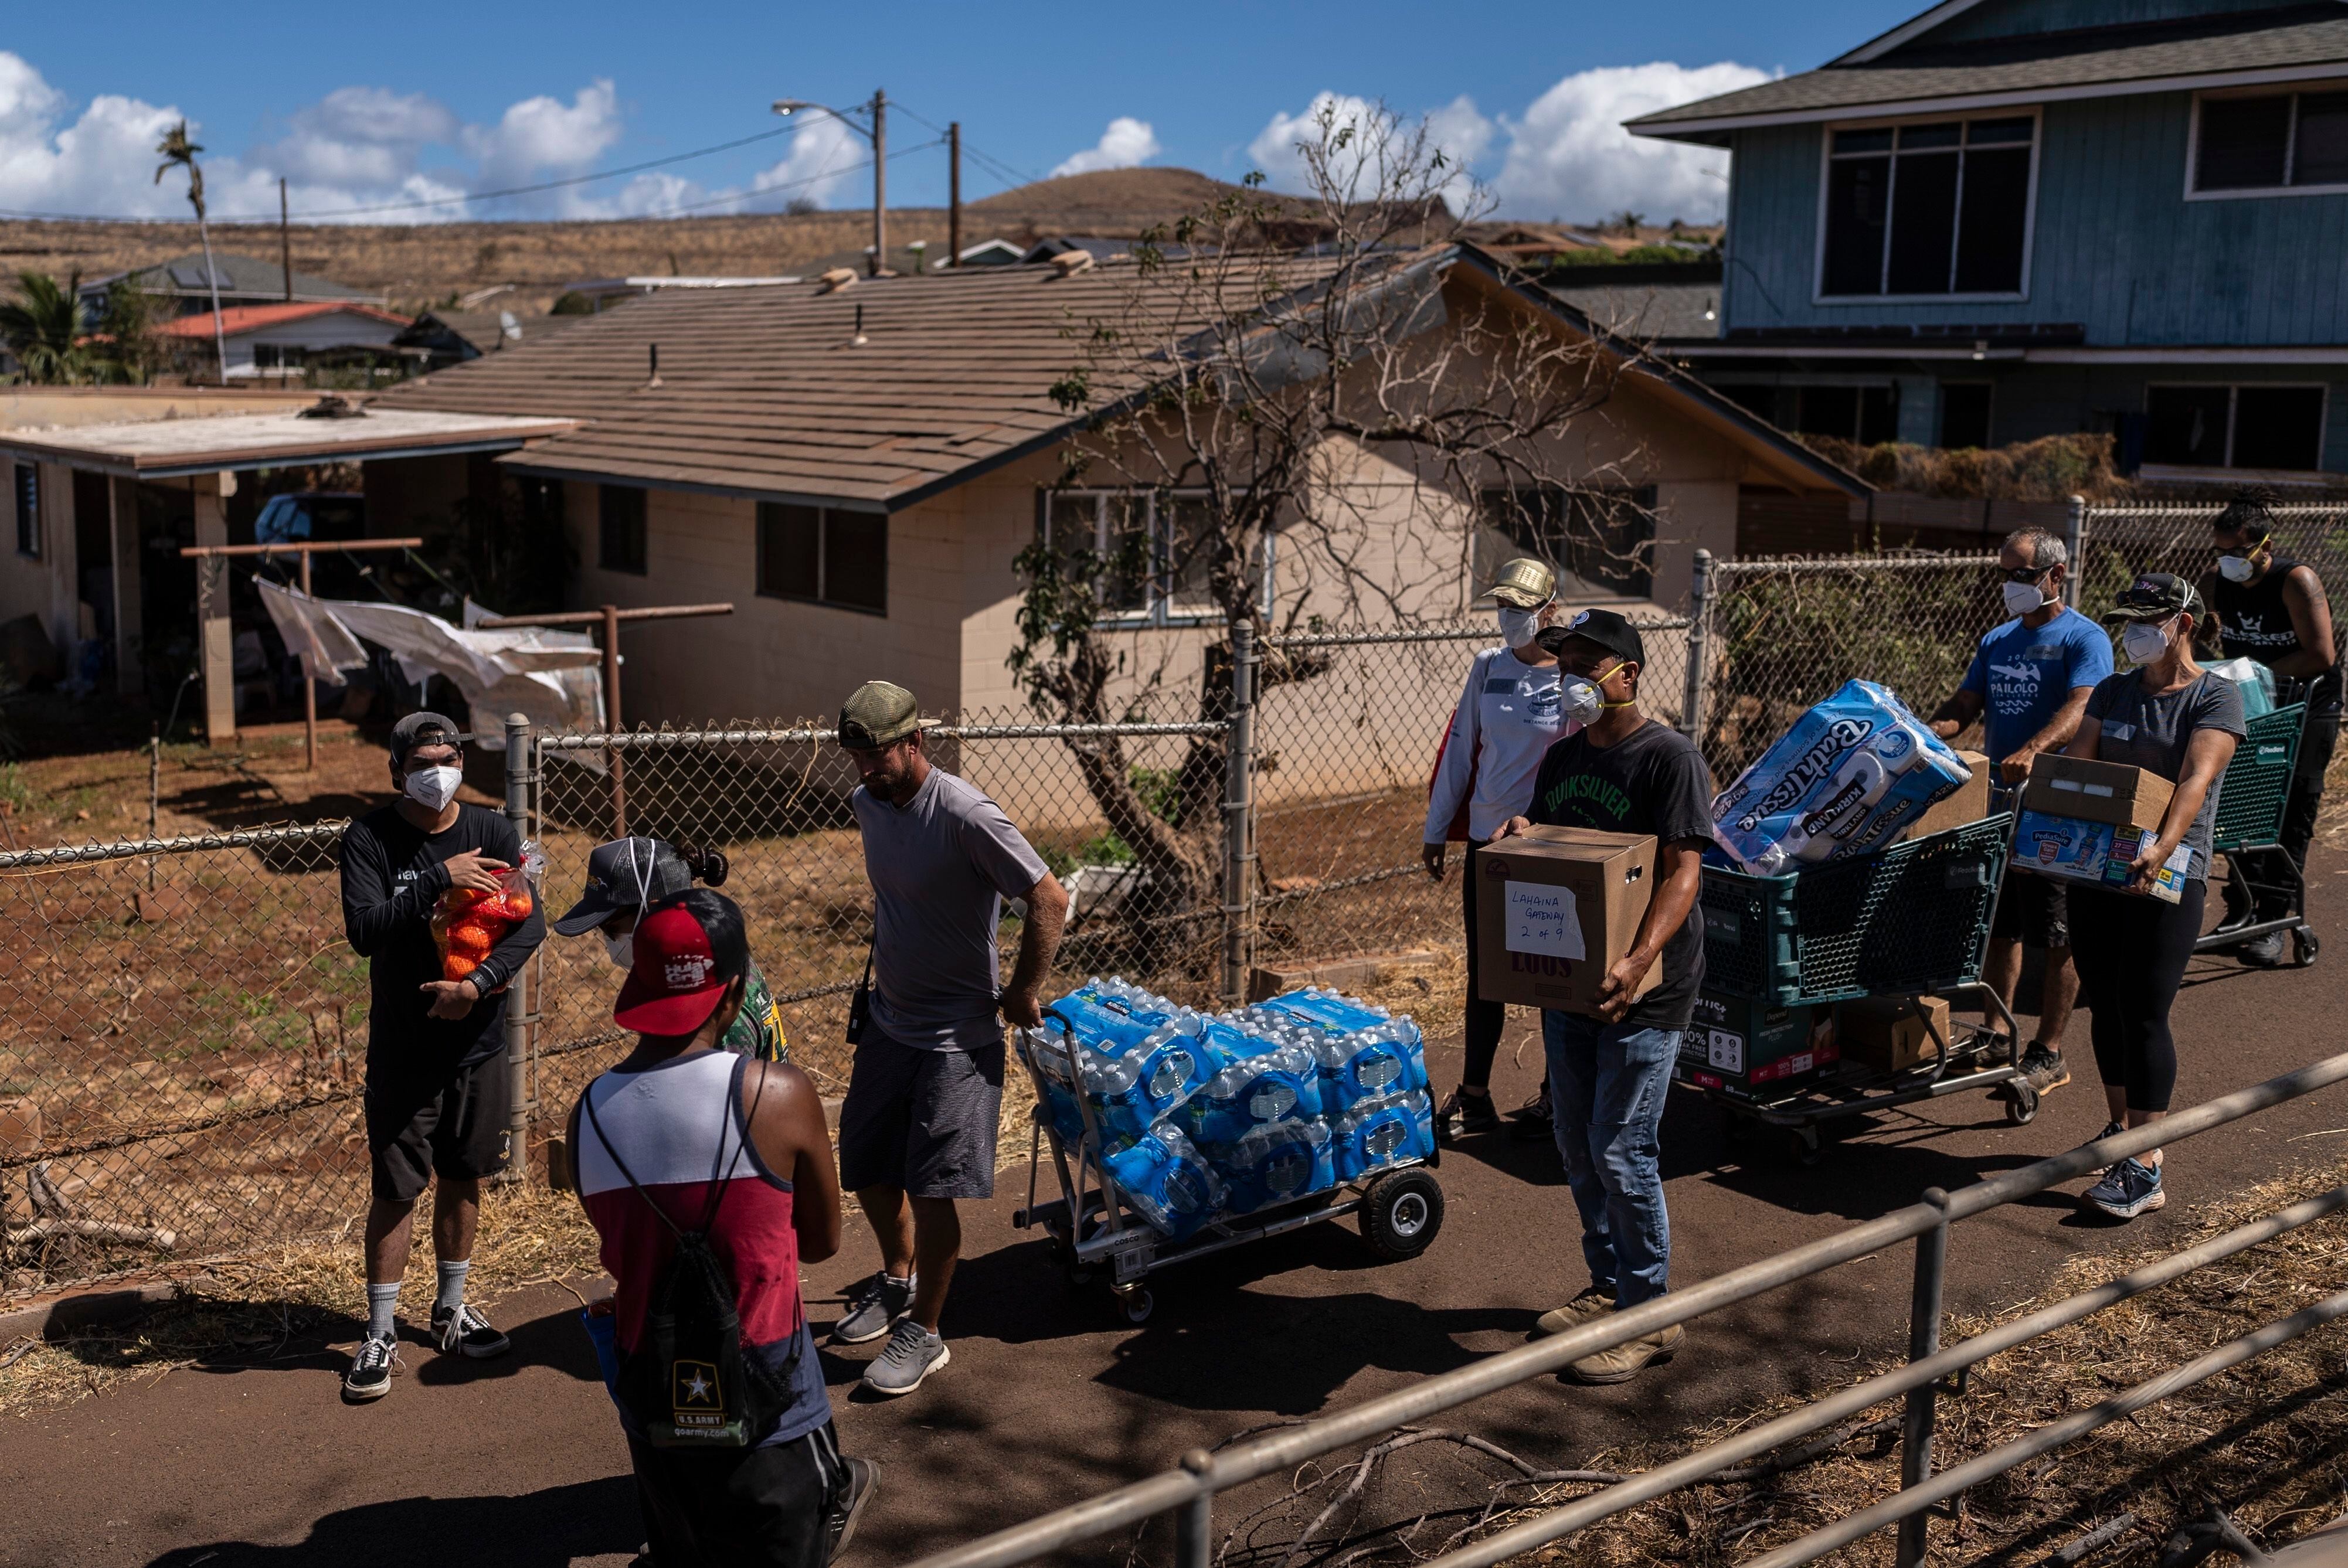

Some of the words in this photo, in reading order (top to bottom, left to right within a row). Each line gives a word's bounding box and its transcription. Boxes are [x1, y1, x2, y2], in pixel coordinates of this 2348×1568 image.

[1990, 683, 2038, 693] PAILOLO
[1815, 715, 1836, 731] Layers
[1809, 732, 1816, 740] of
[1788, 740, 1810, 763] Softness
[1775, 766, 1786, 778] and
[1545, 774, 1630, 821] QUIKSILVER
[1807, 787, 1862, 833] KIRKLAND
[1833, 808, 1867, 838] KIRKLAND
[2034, 833, 2069, 845] PediaSure
[1512, 891, 1559, 906] LAHAINA
[1525, 908, 1564, 925] GATEWAY
[1521, 926, 1530, 937] 2
[1539, 929, 1549, 940] of
[1556, 928, 1563, 941] 9
[665, 962, 704, 974] Hula
[1106, 1001, 1130, 1015] KIRKLAND
[1692, 1044, 1707, 1053] FREE
[1725, 1085, 1735, 1093] 88
[1114, 1235, 1139, 1246] COSCO
[674, 1428, 729, 1438] goarmy.com
